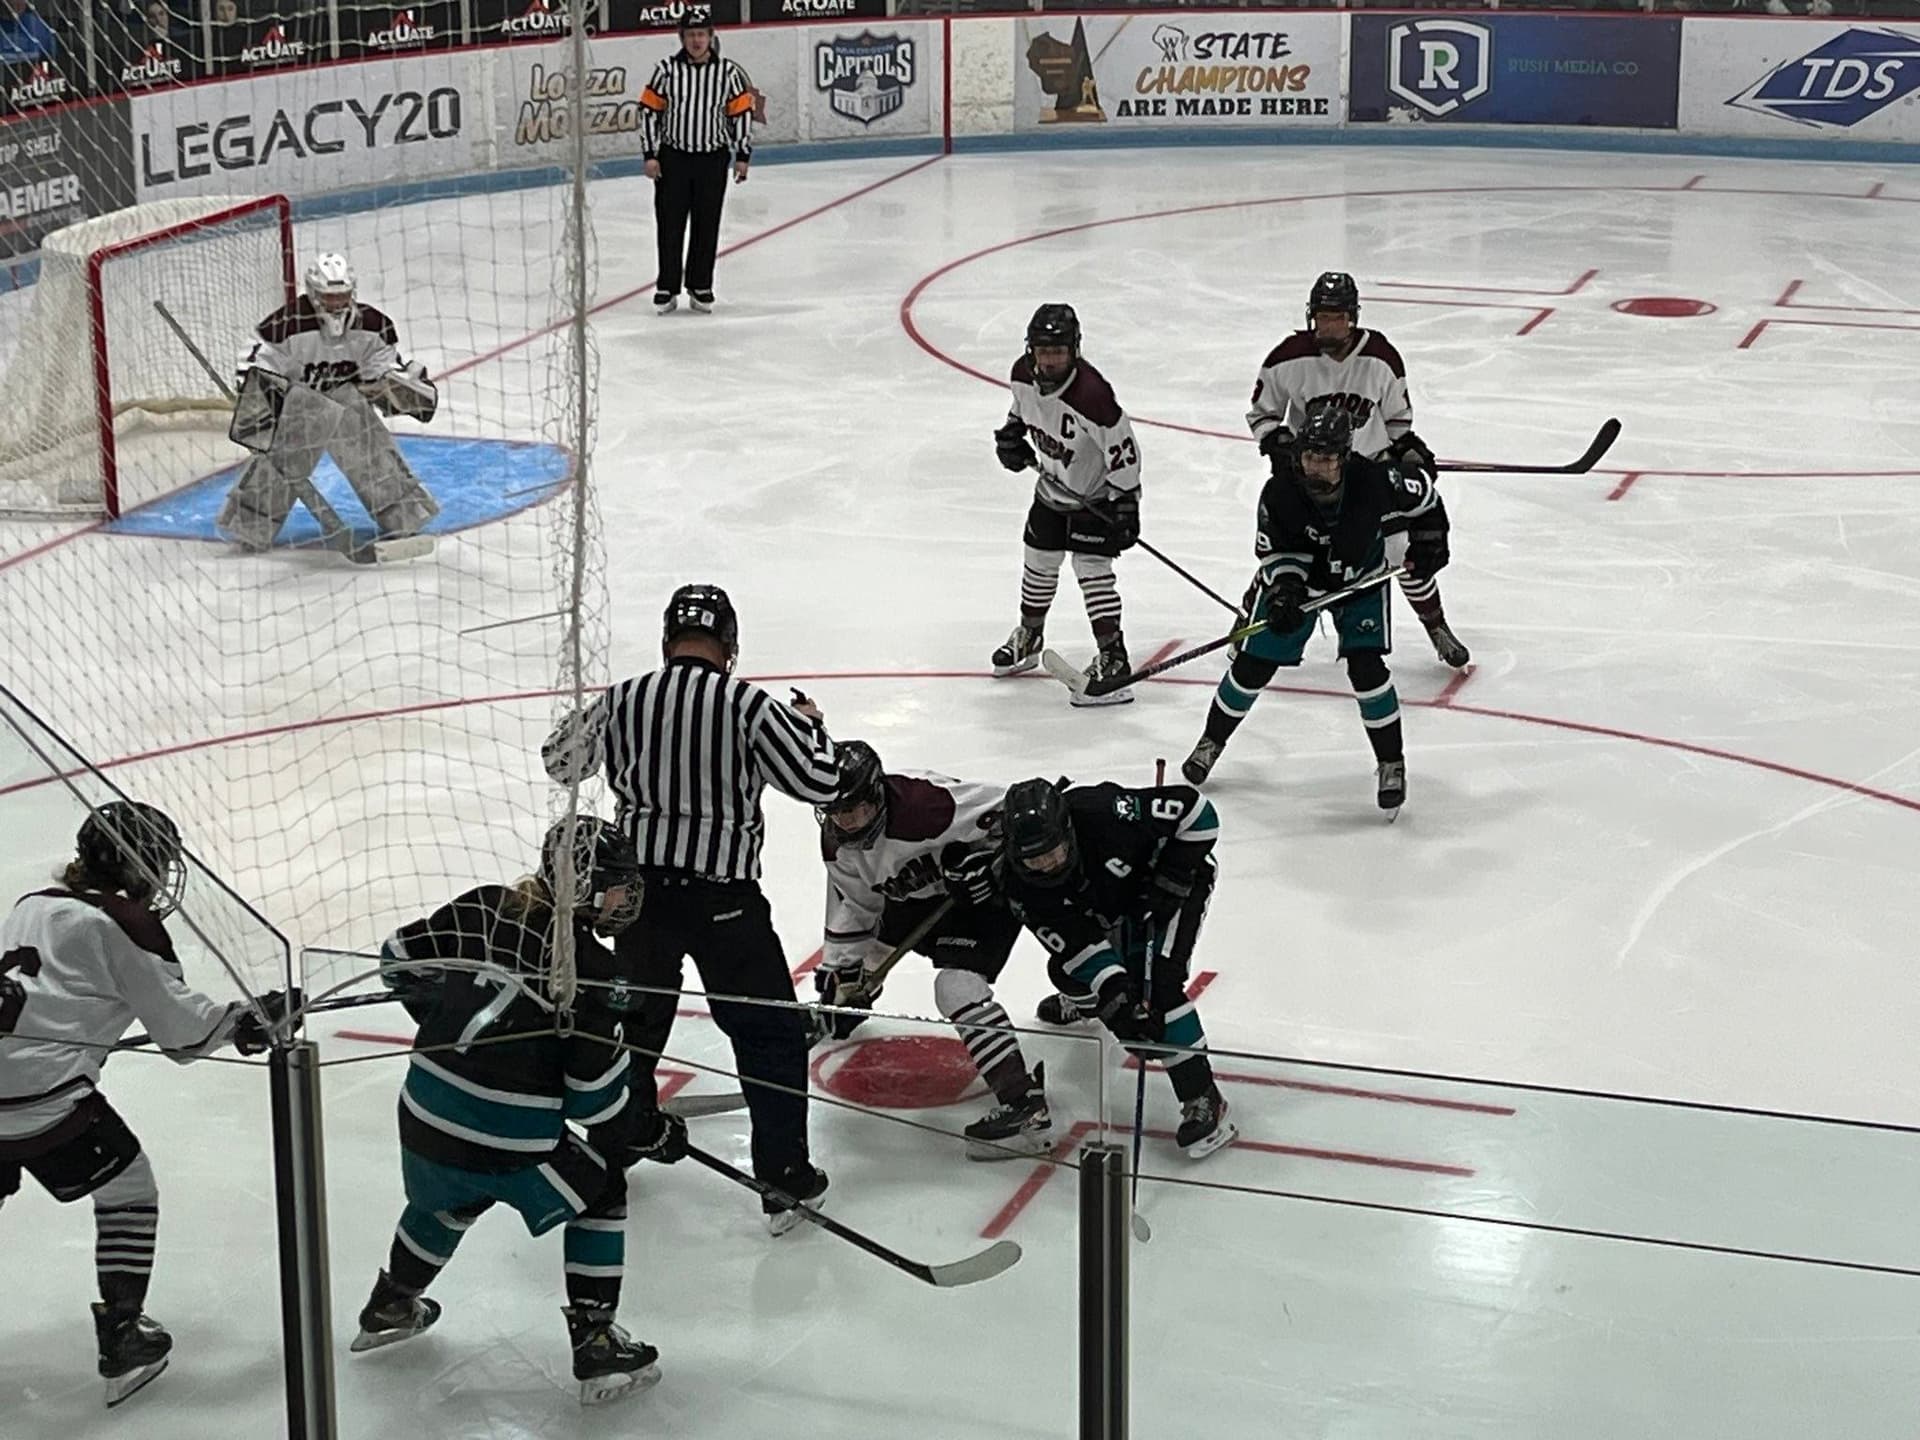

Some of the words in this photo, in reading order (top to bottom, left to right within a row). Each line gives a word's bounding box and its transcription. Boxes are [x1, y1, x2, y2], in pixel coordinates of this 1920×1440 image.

[368, 25, 434, 46] ACTUATE
[1194, 32, 1292, 60] STATE
[241, 40, 304, 63] ACTUATE
[121, 58, 182, 82] ACTUATE
[818, 42, 913, 88] CAPITOLS
[1418, 41, 1460, 89] R
[1508, 59, 1549, 73] RUSH
[1555, 60, 1608, 75] MEDIA
[1612, 61, 1639, 75] CO
[11, 76, 66, 101] ACTUATE
[1136, 63, 1311, 95] CHAMPIONS
[1799, 58, 1904, 100] TDS
[1116, 98, 1167, 117] ARE
[1175, 98, 1251, 116] MADE
[1260, 97, 1329, 116] HERE
[25, 132, 61, 158] SHELF
[141, 87, 462, 188] LEGACY20
[1060, 412, 1076, 440] C
[1109, 436, 1138, 472] 23
[1404, 477, 1424, 497] 9
[1151, 798, 1185, 821] 6
[1105, 857, 1132, 878] C
[1036, 926, 1066, 953] 6
[454, 970, 523, 1054] 7
